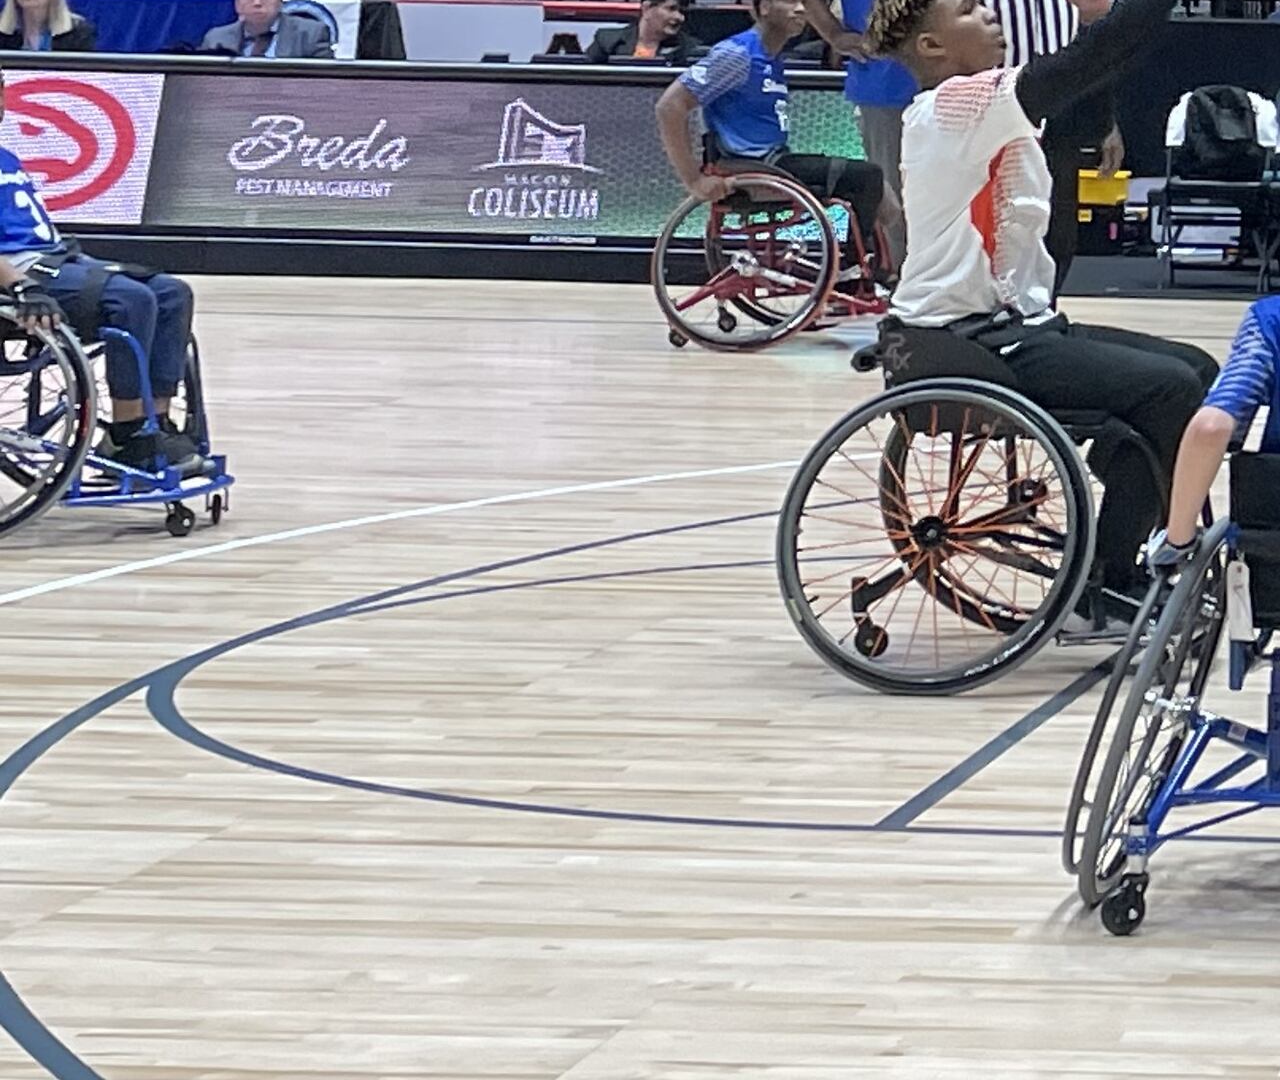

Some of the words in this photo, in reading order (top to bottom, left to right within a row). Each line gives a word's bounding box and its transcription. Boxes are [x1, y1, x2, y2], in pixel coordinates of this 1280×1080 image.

[227, 114, 410, 172] Breda
[235, 178, 274, 195] PEST
[275, 179, 393, 198] MANAGEMENT
[468, 187, 600, 220] COLISEUM
